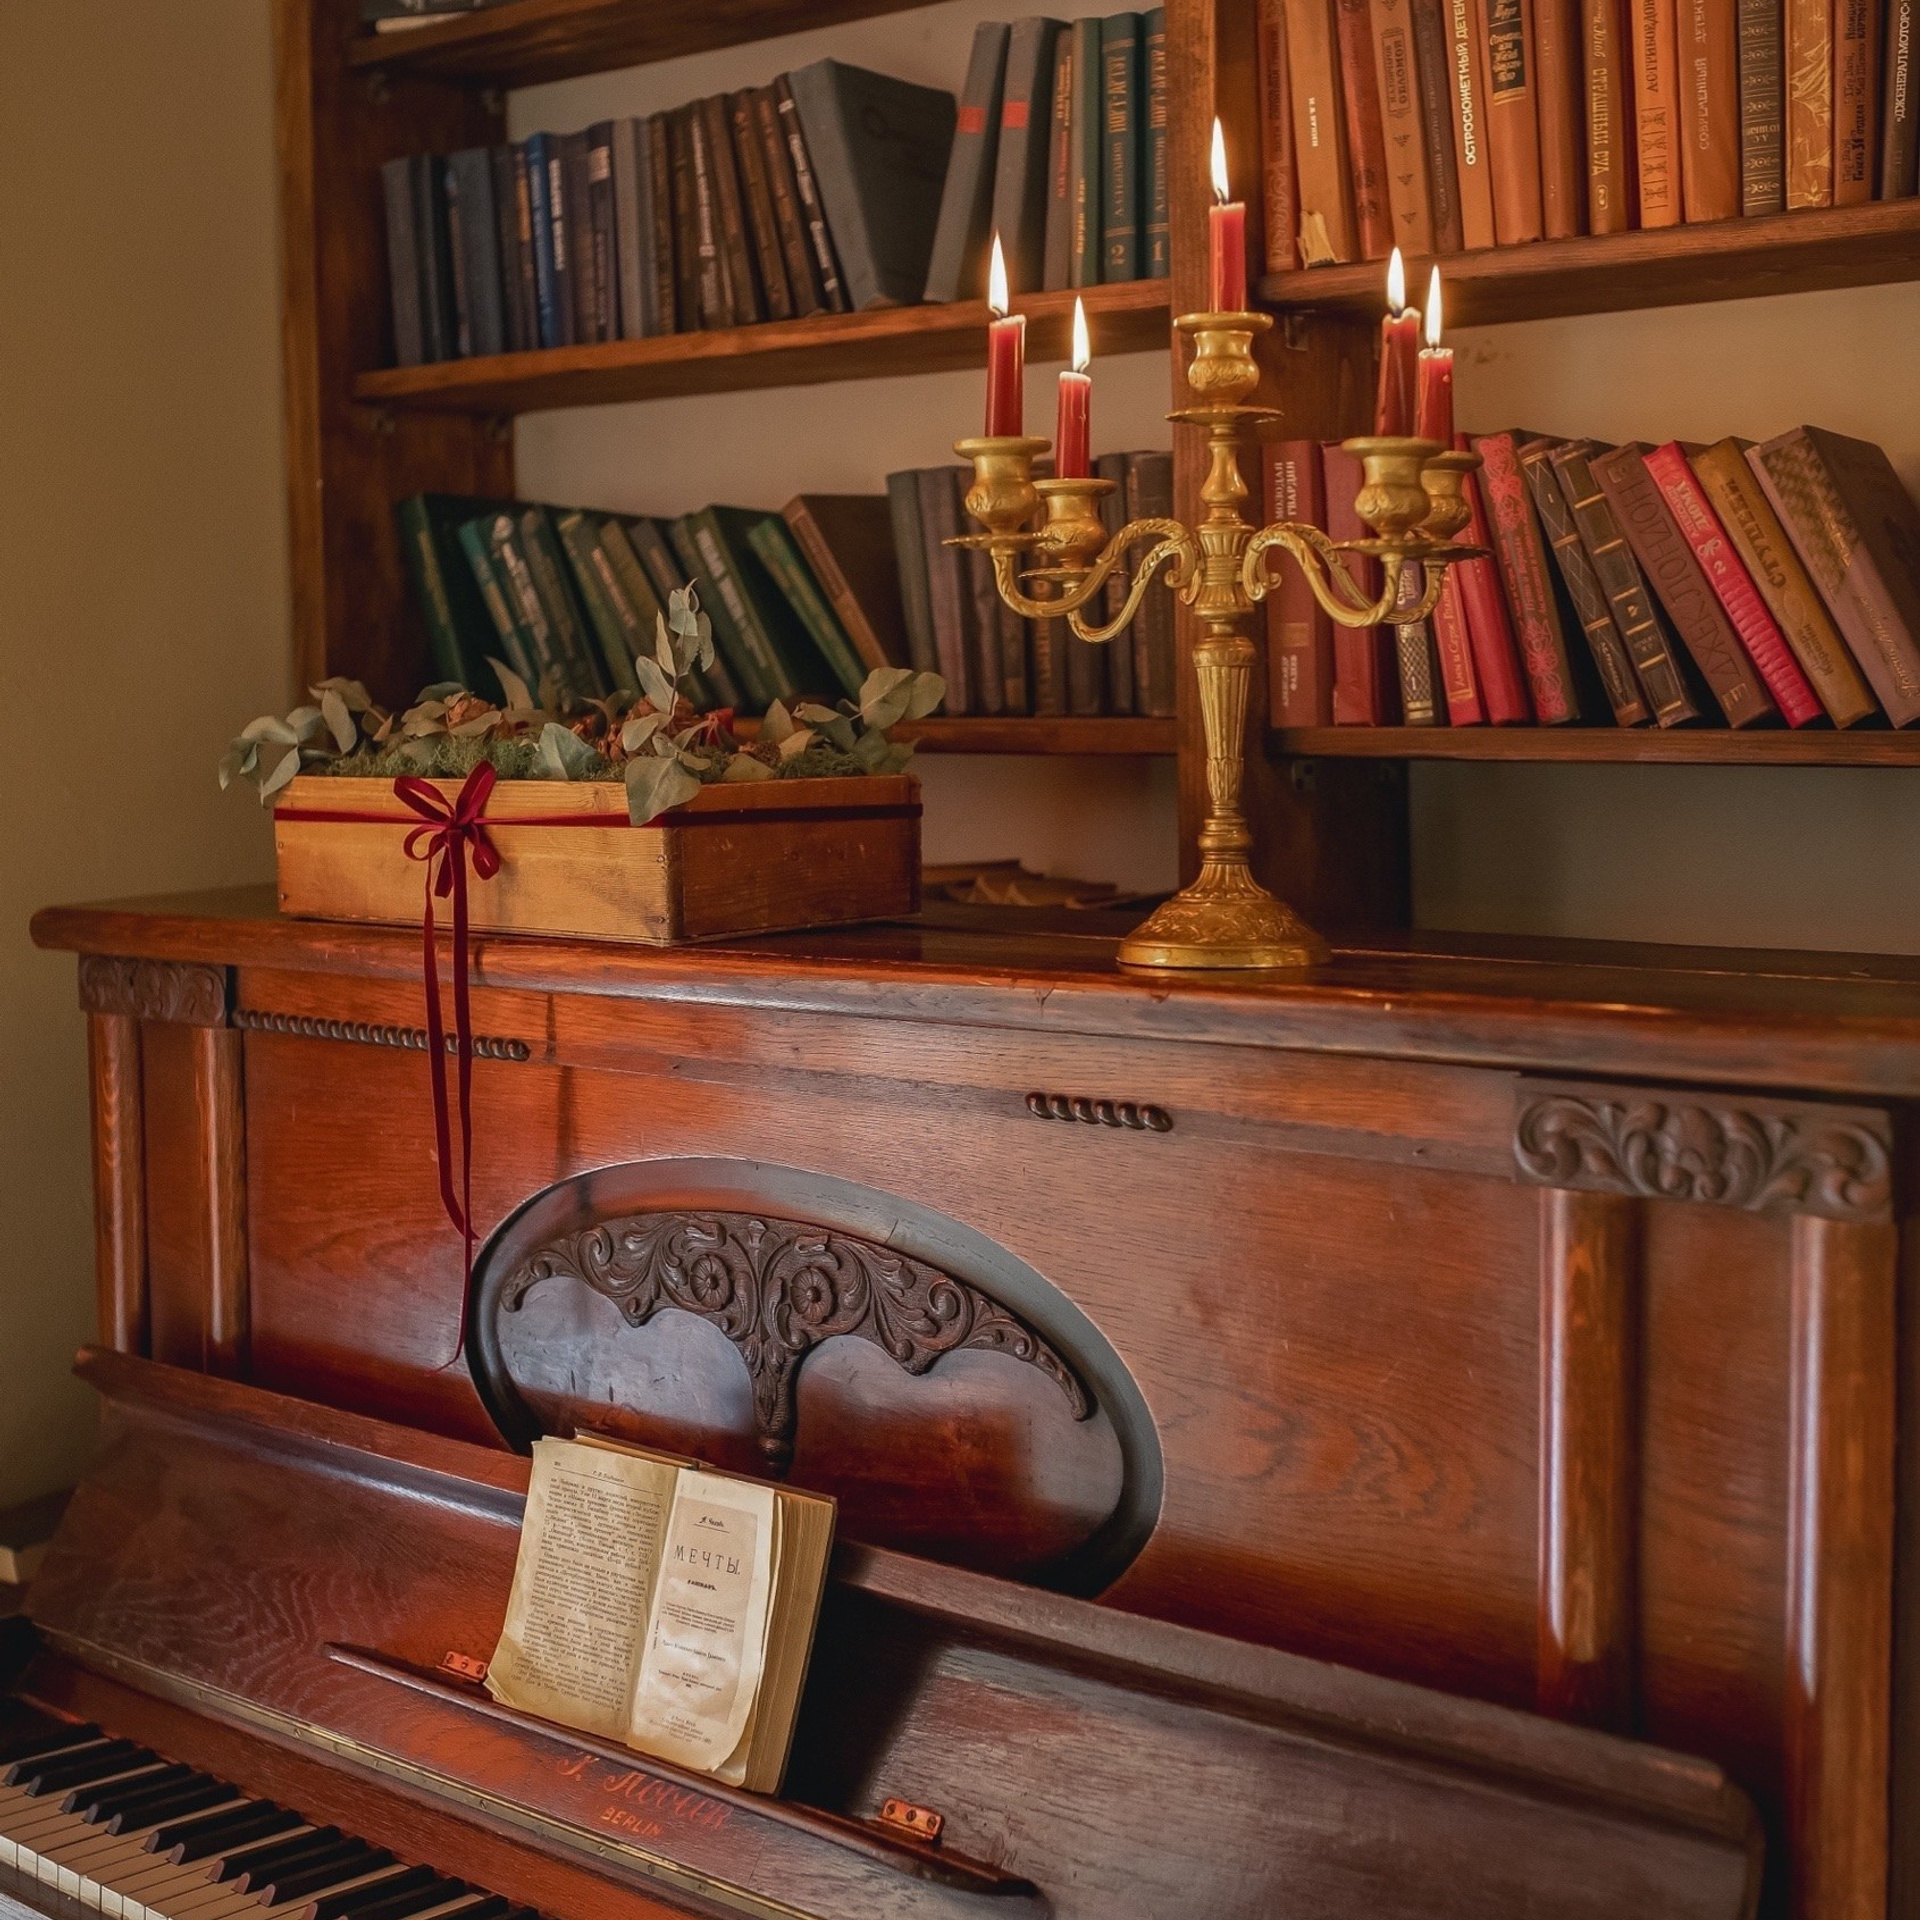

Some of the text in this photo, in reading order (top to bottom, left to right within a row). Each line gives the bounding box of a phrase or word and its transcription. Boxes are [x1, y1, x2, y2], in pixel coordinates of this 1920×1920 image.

[1455, 43, 1477, 165] ОСТРОСЮЖЕТНЫЙ
[1591, 150, 1610, 176] СУД
[1111, 244, 1125, 265] 2
[1153, 241, 1164, 262] 1
[1273, 461, 1285, 520] МОЛОДАЯ
[1673, 479, 1709, 530] ДЮМА
[1617, 478, 1742, 678] ДЖЕК ЛОНДОН
[600, 1806, 664, 1839] BERLIN
